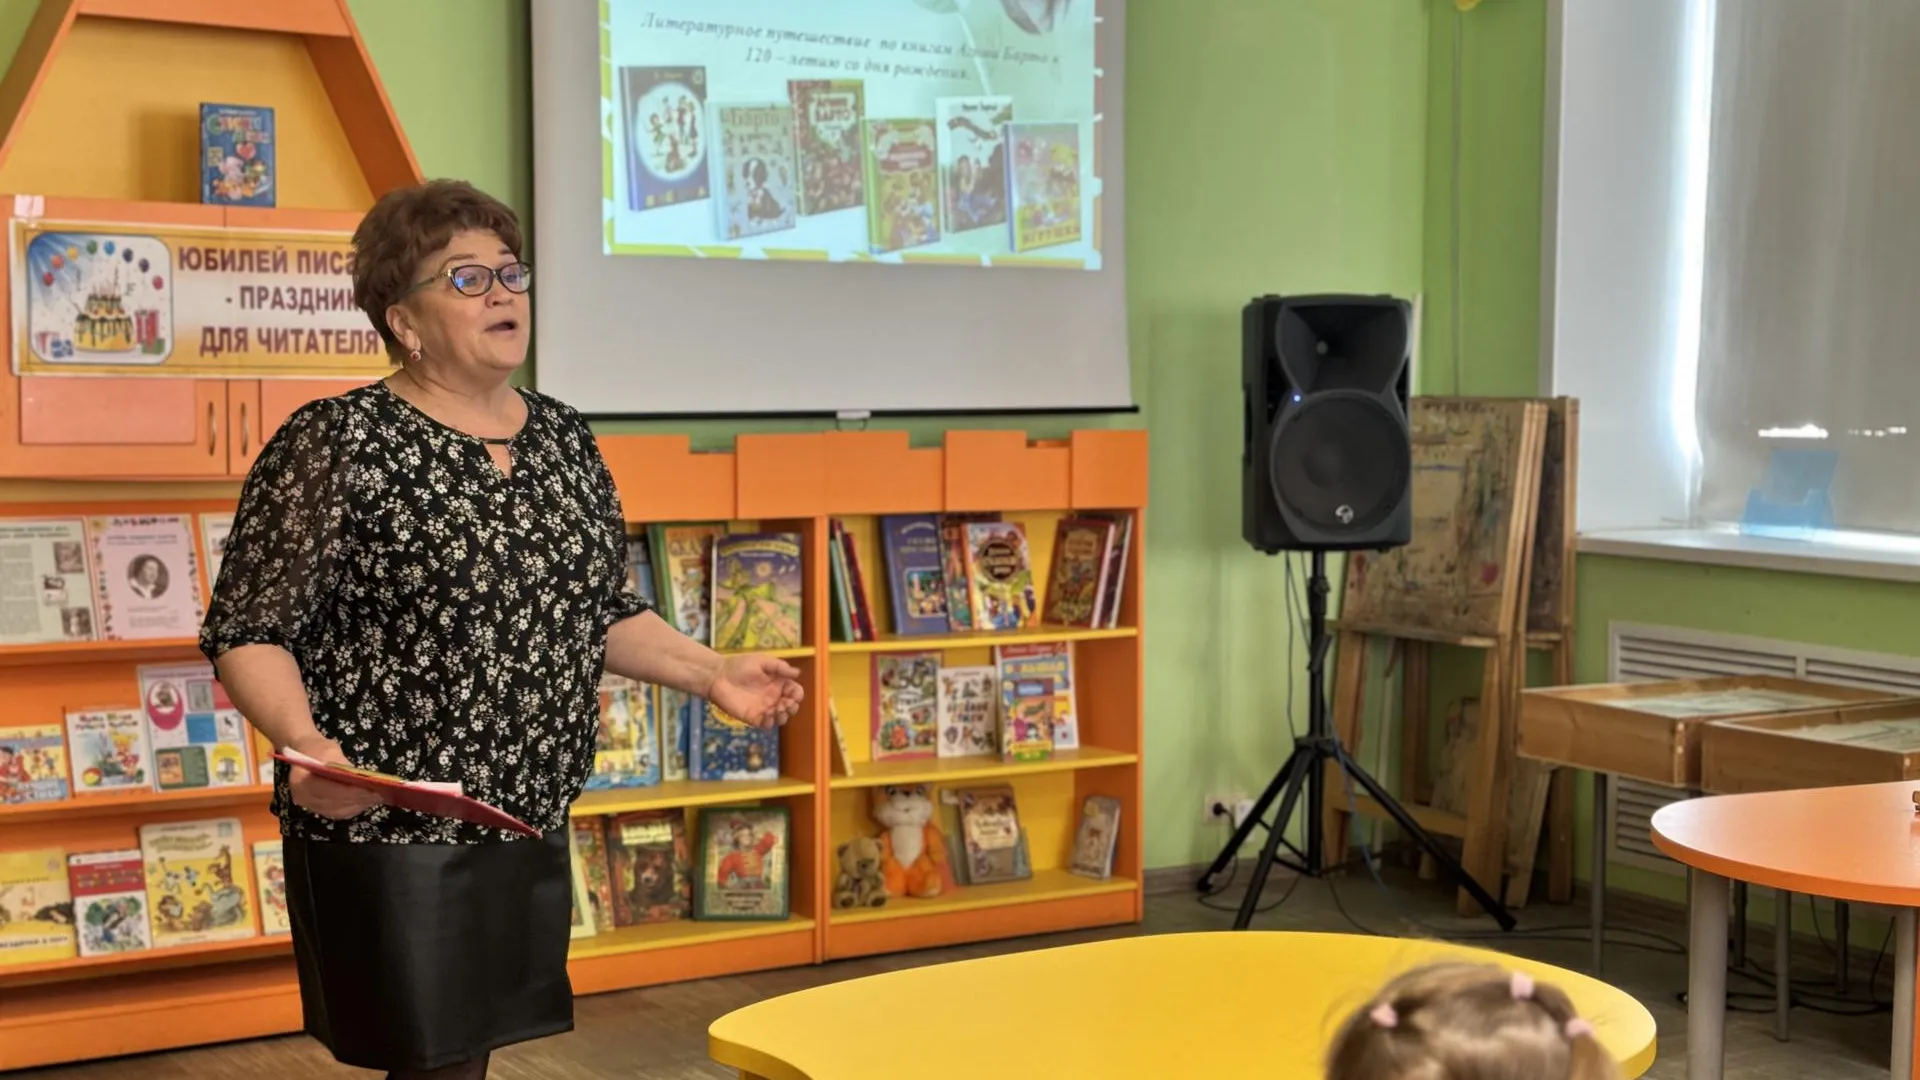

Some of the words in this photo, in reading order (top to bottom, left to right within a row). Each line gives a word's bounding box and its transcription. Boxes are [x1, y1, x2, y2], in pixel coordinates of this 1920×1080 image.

[641, 12, 763, 39] Литературное
[766, 27, 871, 49] путешествие
[880, 37, 897, 49] по
[902, 40, 953, 55] книгам
[745, 47, 772, 63] 120
[844, 60, 860, 71] со
[864, 59, 890, 73] дня
[178, 245, 289, 274] ЮБИЛЕЙ
[240, 285, 359, 316] ПРАЗДНИК
[199, 326, 249, 358] ДЛЯ
[257, 327, 379, 356] ЧИТАТЕЛЯ
